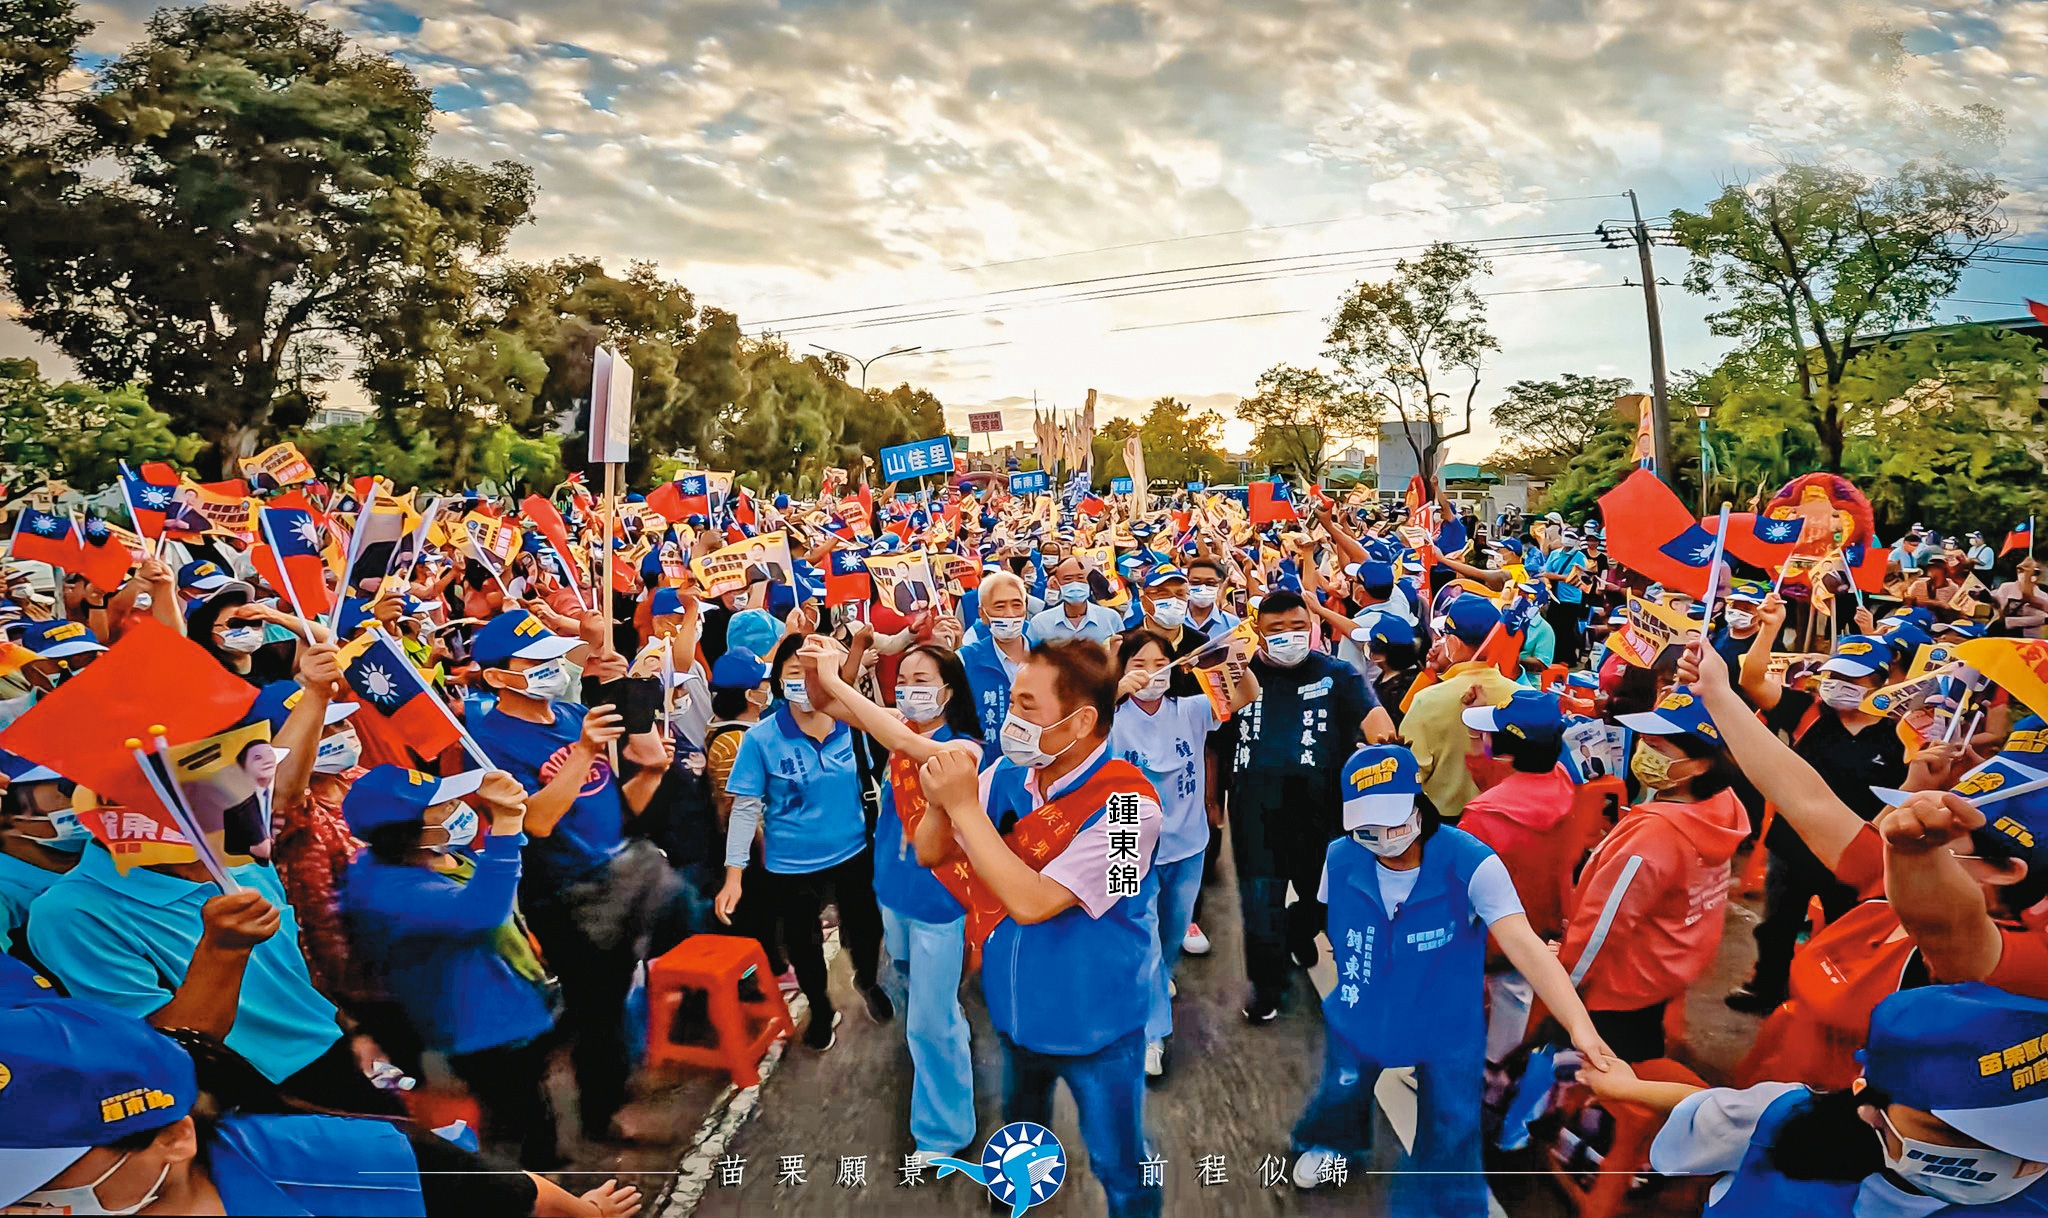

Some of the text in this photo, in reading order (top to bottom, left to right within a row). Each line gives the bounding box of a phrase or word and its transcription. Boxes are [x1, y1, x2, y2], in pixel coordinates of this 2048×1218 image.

[886, 443, 950, 476] 山佳里
[1012, 474, 1045, 490] 新南里
